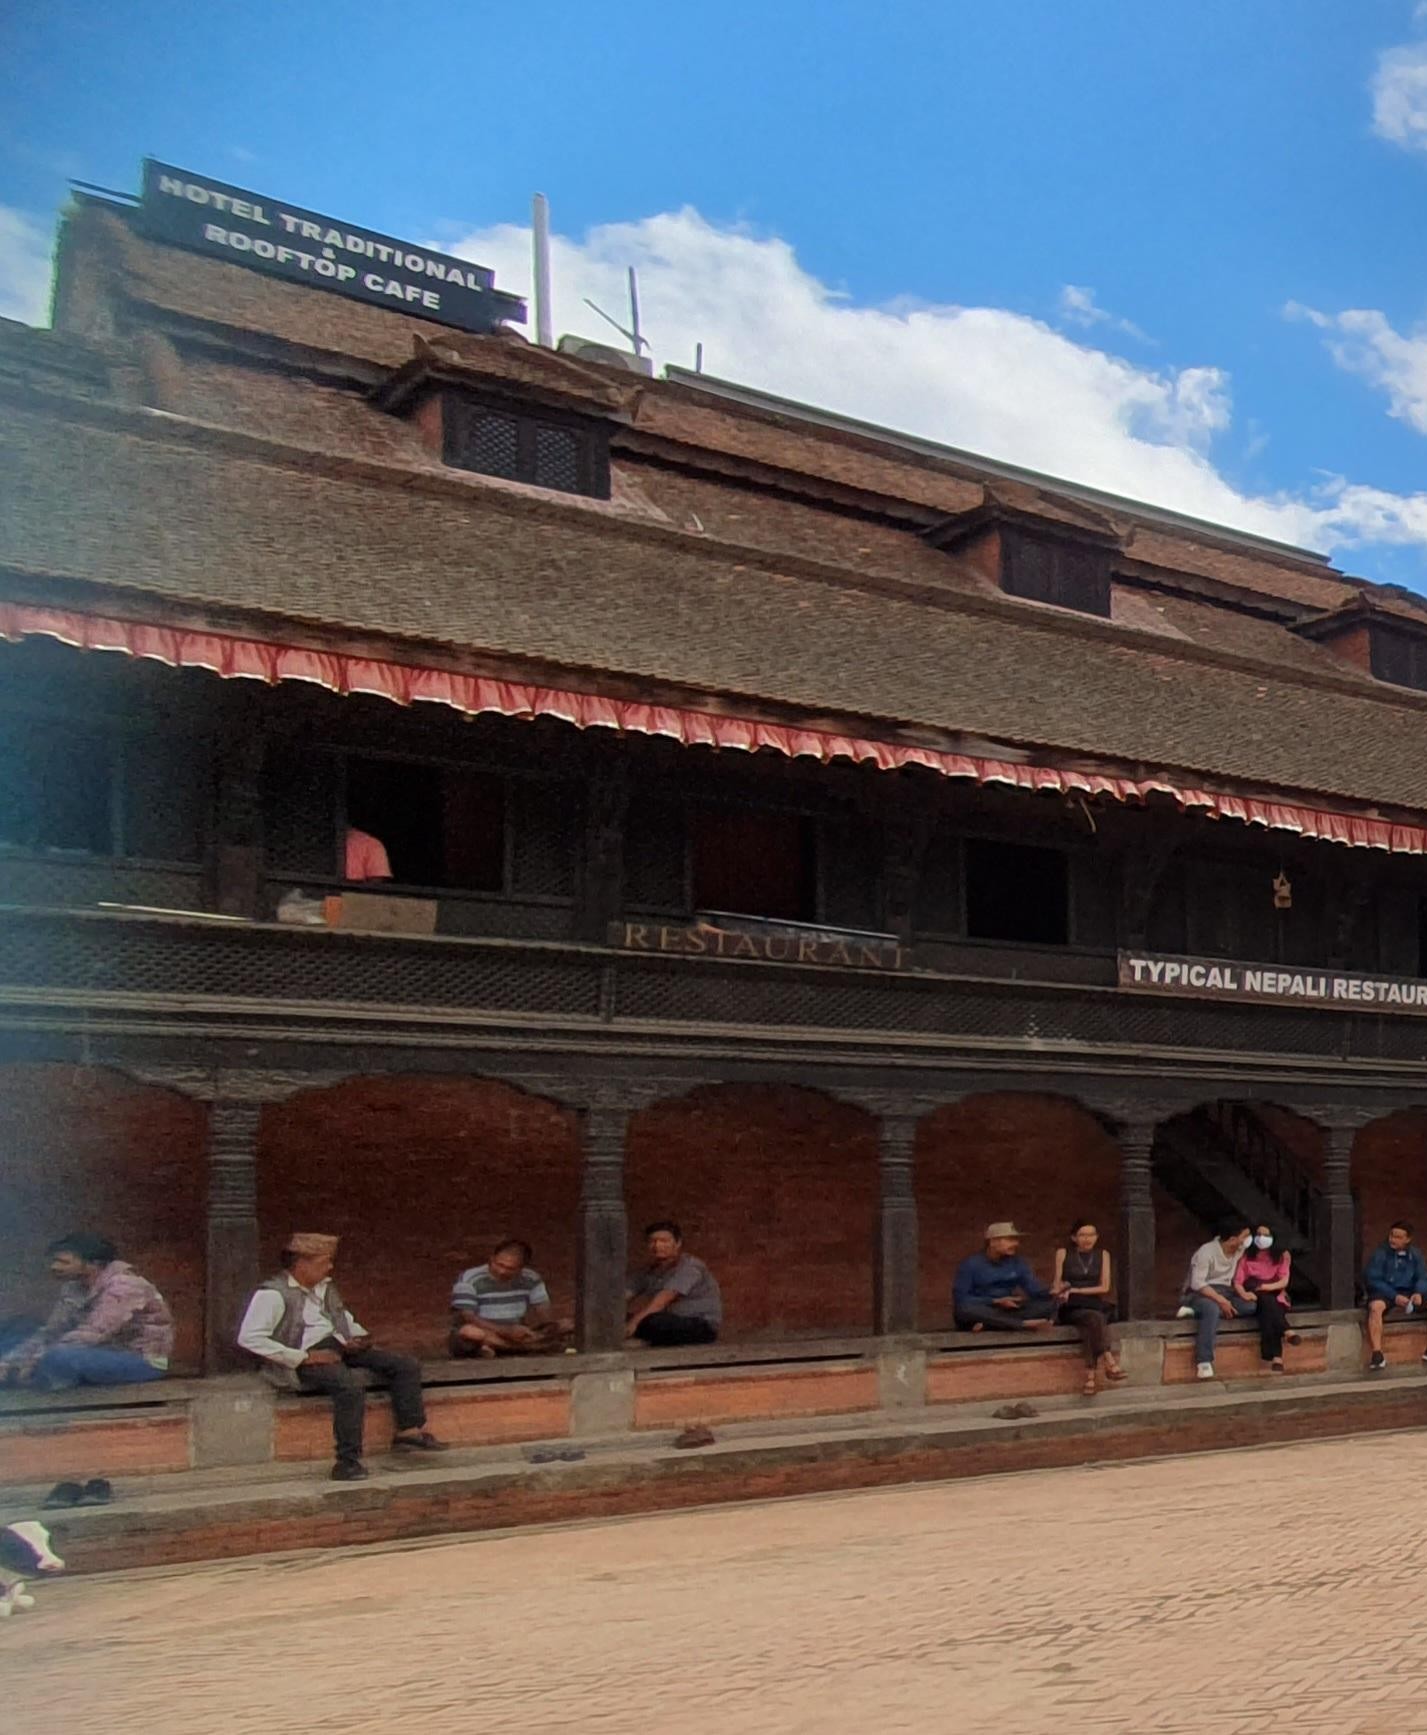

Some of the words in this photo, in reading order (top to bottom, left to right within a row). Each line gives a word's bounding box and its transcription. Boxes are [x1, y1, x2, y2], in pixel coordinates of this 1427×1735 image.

[159, 174, 271, 225] HOTEL
[279, 212, 483, 293] TRADITIONAL
[322, 247, 337, 260] &
[204, 223, 357, 282] ROOFTOP
[363, 273, 441, 311] CAFE
[624, 922, 911, 969] RESTAURANT
[1129, 958, 1238, 990] TYPICAL
[1245, 970, 1326, 997] NEPALI
